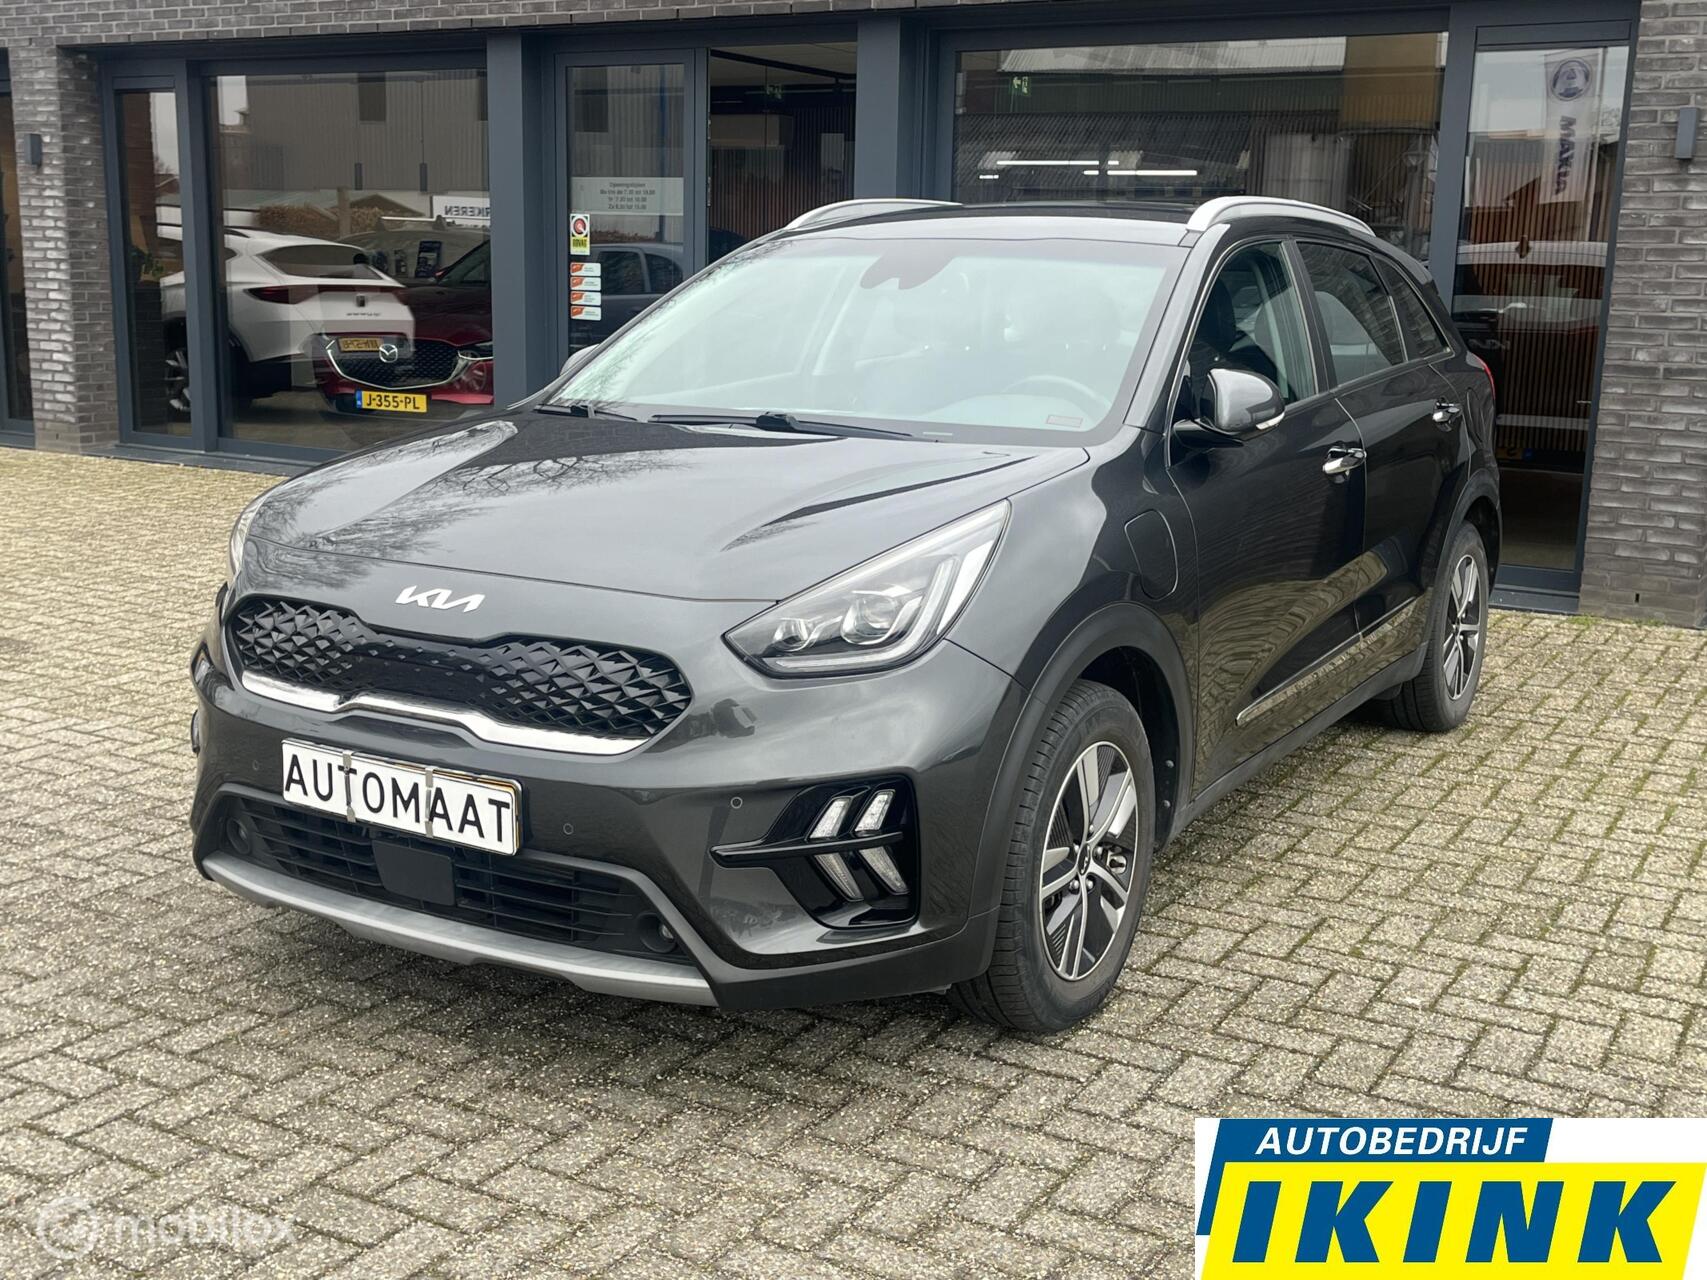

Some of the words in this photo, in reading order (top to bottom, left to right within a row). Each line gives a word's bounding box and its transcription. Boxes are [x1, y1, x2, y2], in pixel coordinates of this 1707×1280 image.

[366, 394, 420, 410] J-355-PL
[395, 585, 486, 612] KIA
[285, 754, 510, 842] AUTOMAAT
